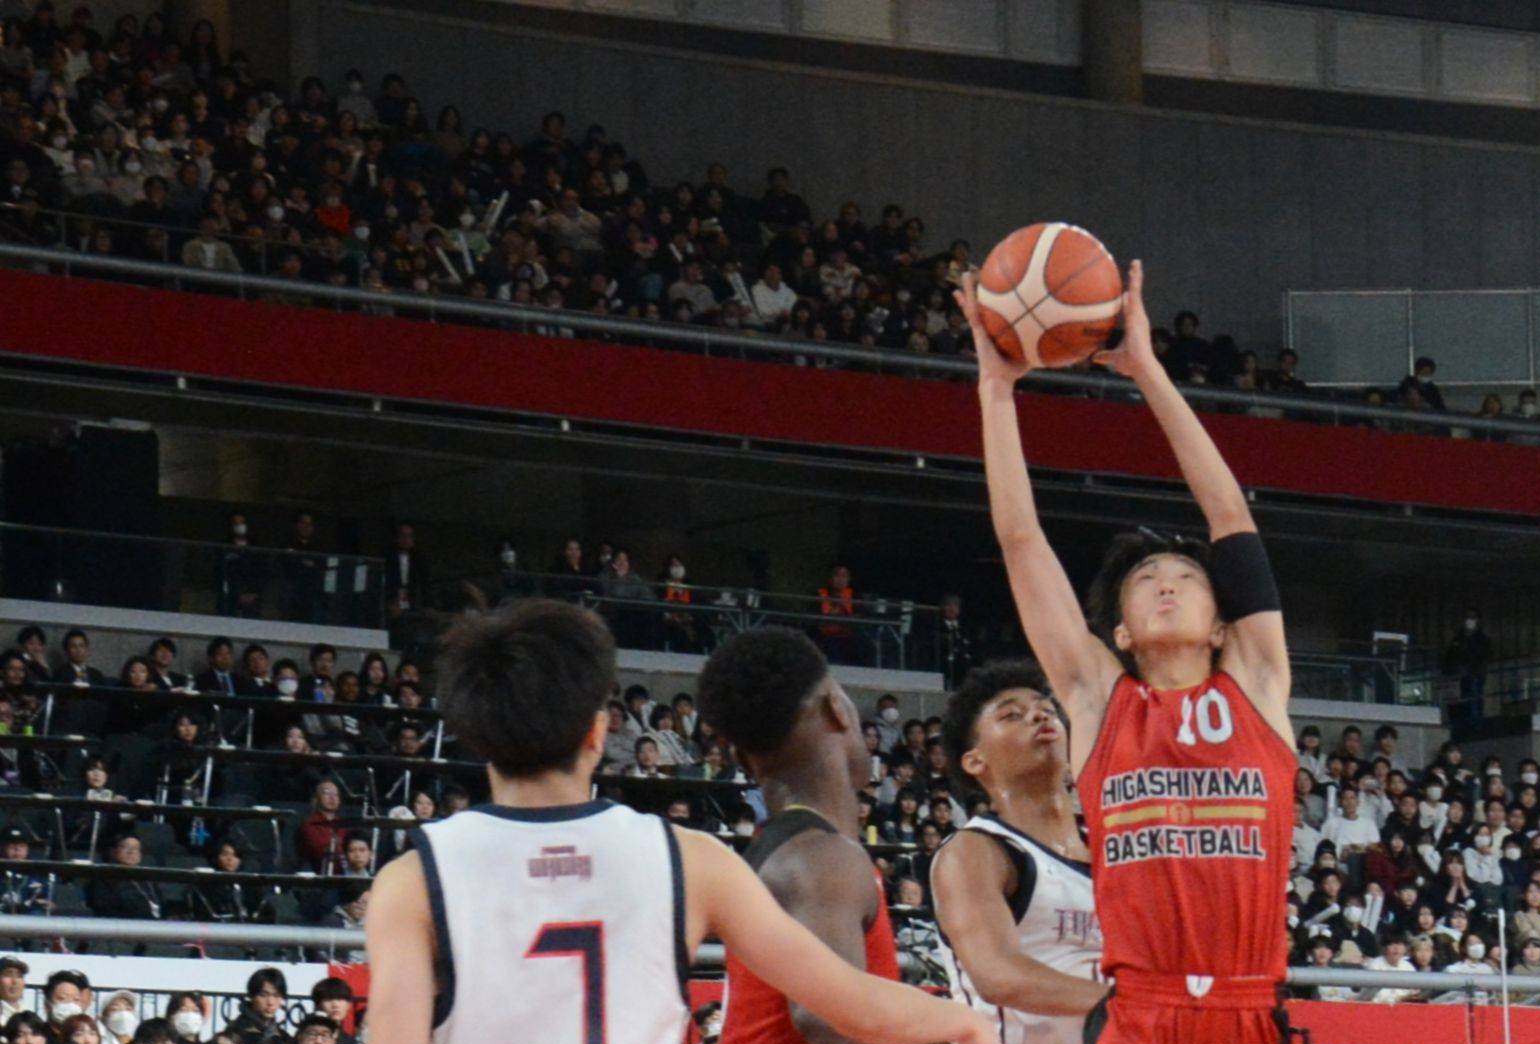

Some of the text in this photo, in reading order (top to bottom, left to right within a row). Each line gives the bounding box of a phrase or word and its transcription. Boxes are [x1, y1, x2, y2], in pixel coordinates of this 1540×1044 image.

[1176, 688, 1234, 746] 10
[1101, 767, 1268, 808] HIGASHIYAMA
[1104, 825, 1266, 867] BASKETBALL
